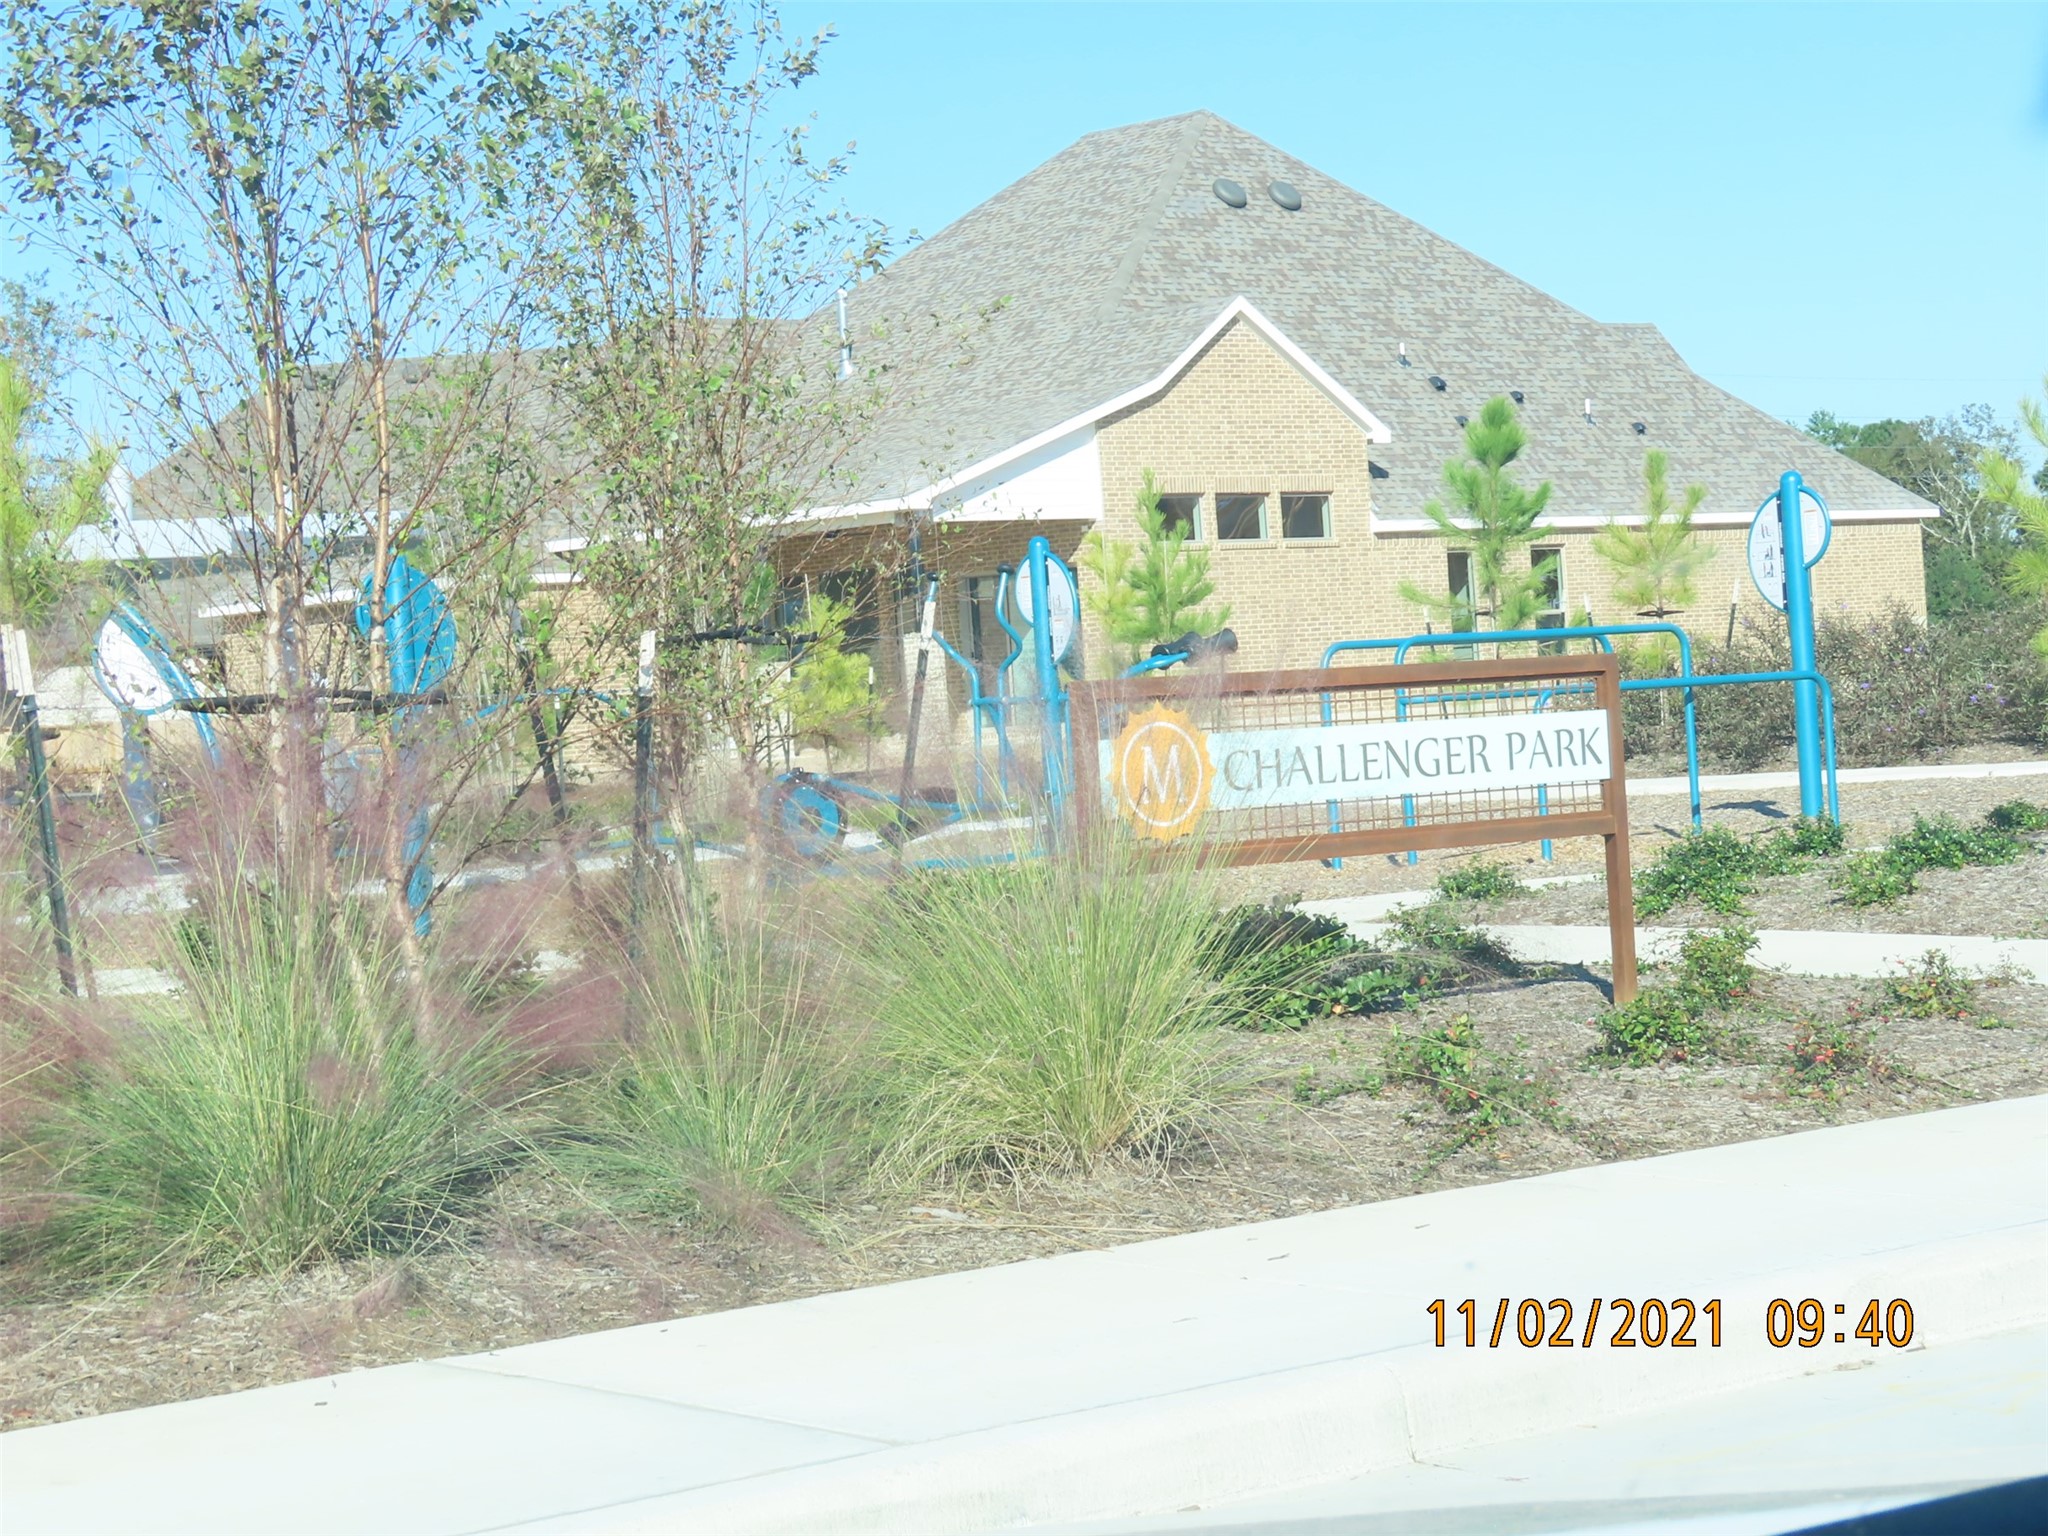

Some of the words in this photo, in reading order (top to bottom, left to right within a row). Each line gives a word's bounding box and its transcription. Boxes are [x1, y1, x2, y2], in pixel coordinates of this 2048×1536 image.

[1141, 744, 1183, 805] M
[1223, 734, 1491, 791] CHALLENGER
[1507, 727, 1603, 771] PARK
